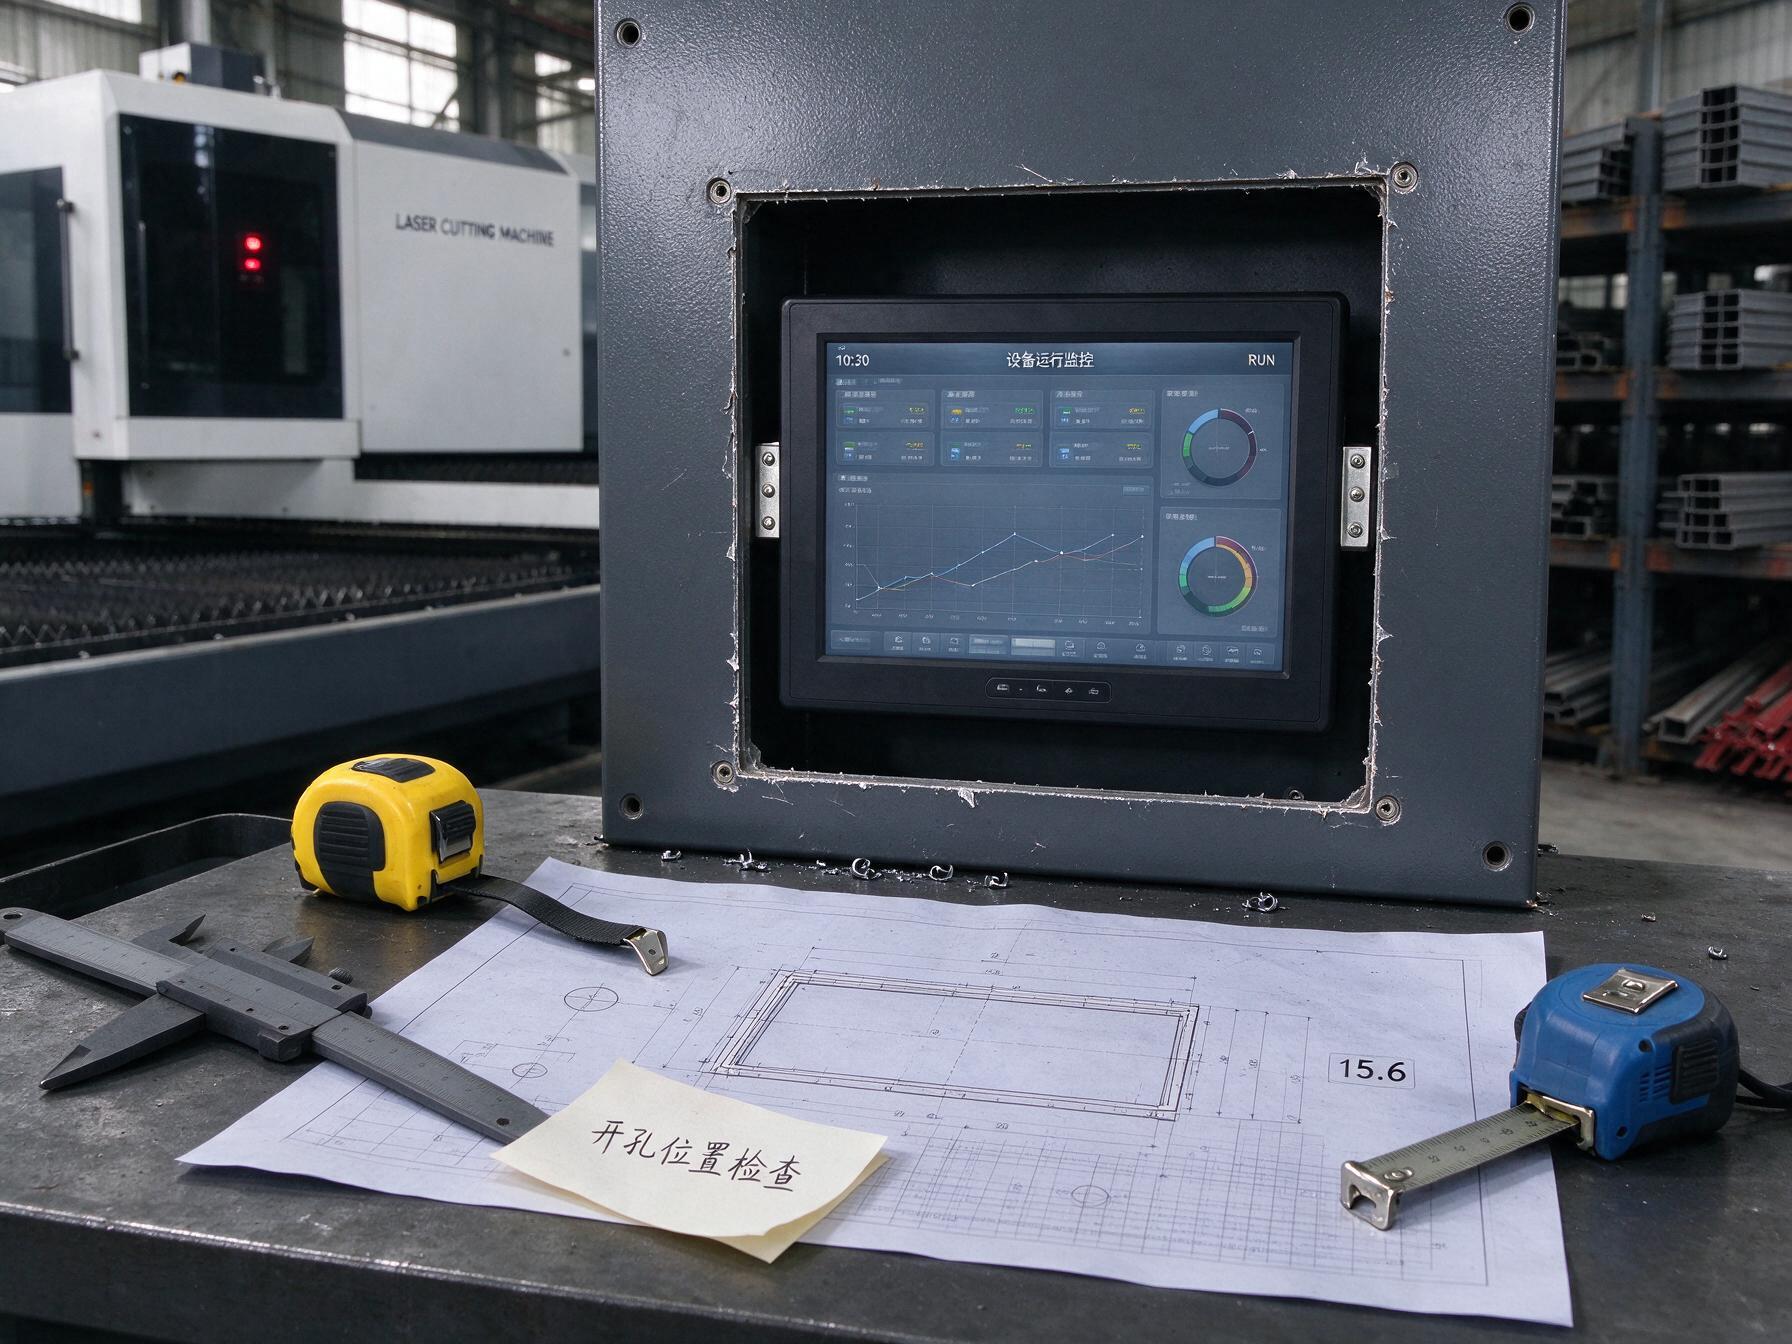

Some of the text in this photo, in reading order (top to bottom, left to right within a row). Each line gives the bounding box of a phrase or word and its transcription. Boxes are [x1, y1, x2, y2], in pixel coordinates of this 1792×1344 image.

[395, 213, 554, 247] LASER CUTTING MACHINE
[835, 354, 870, 367] 10:30
[1006, 351, 1095, 368] 设备运行监控
[1248, 354, 1276, 367] RUN
[1340, 1058, 1407, 1082] 15.6
[591, 1120, 802, 1192] 开孔位置检查
